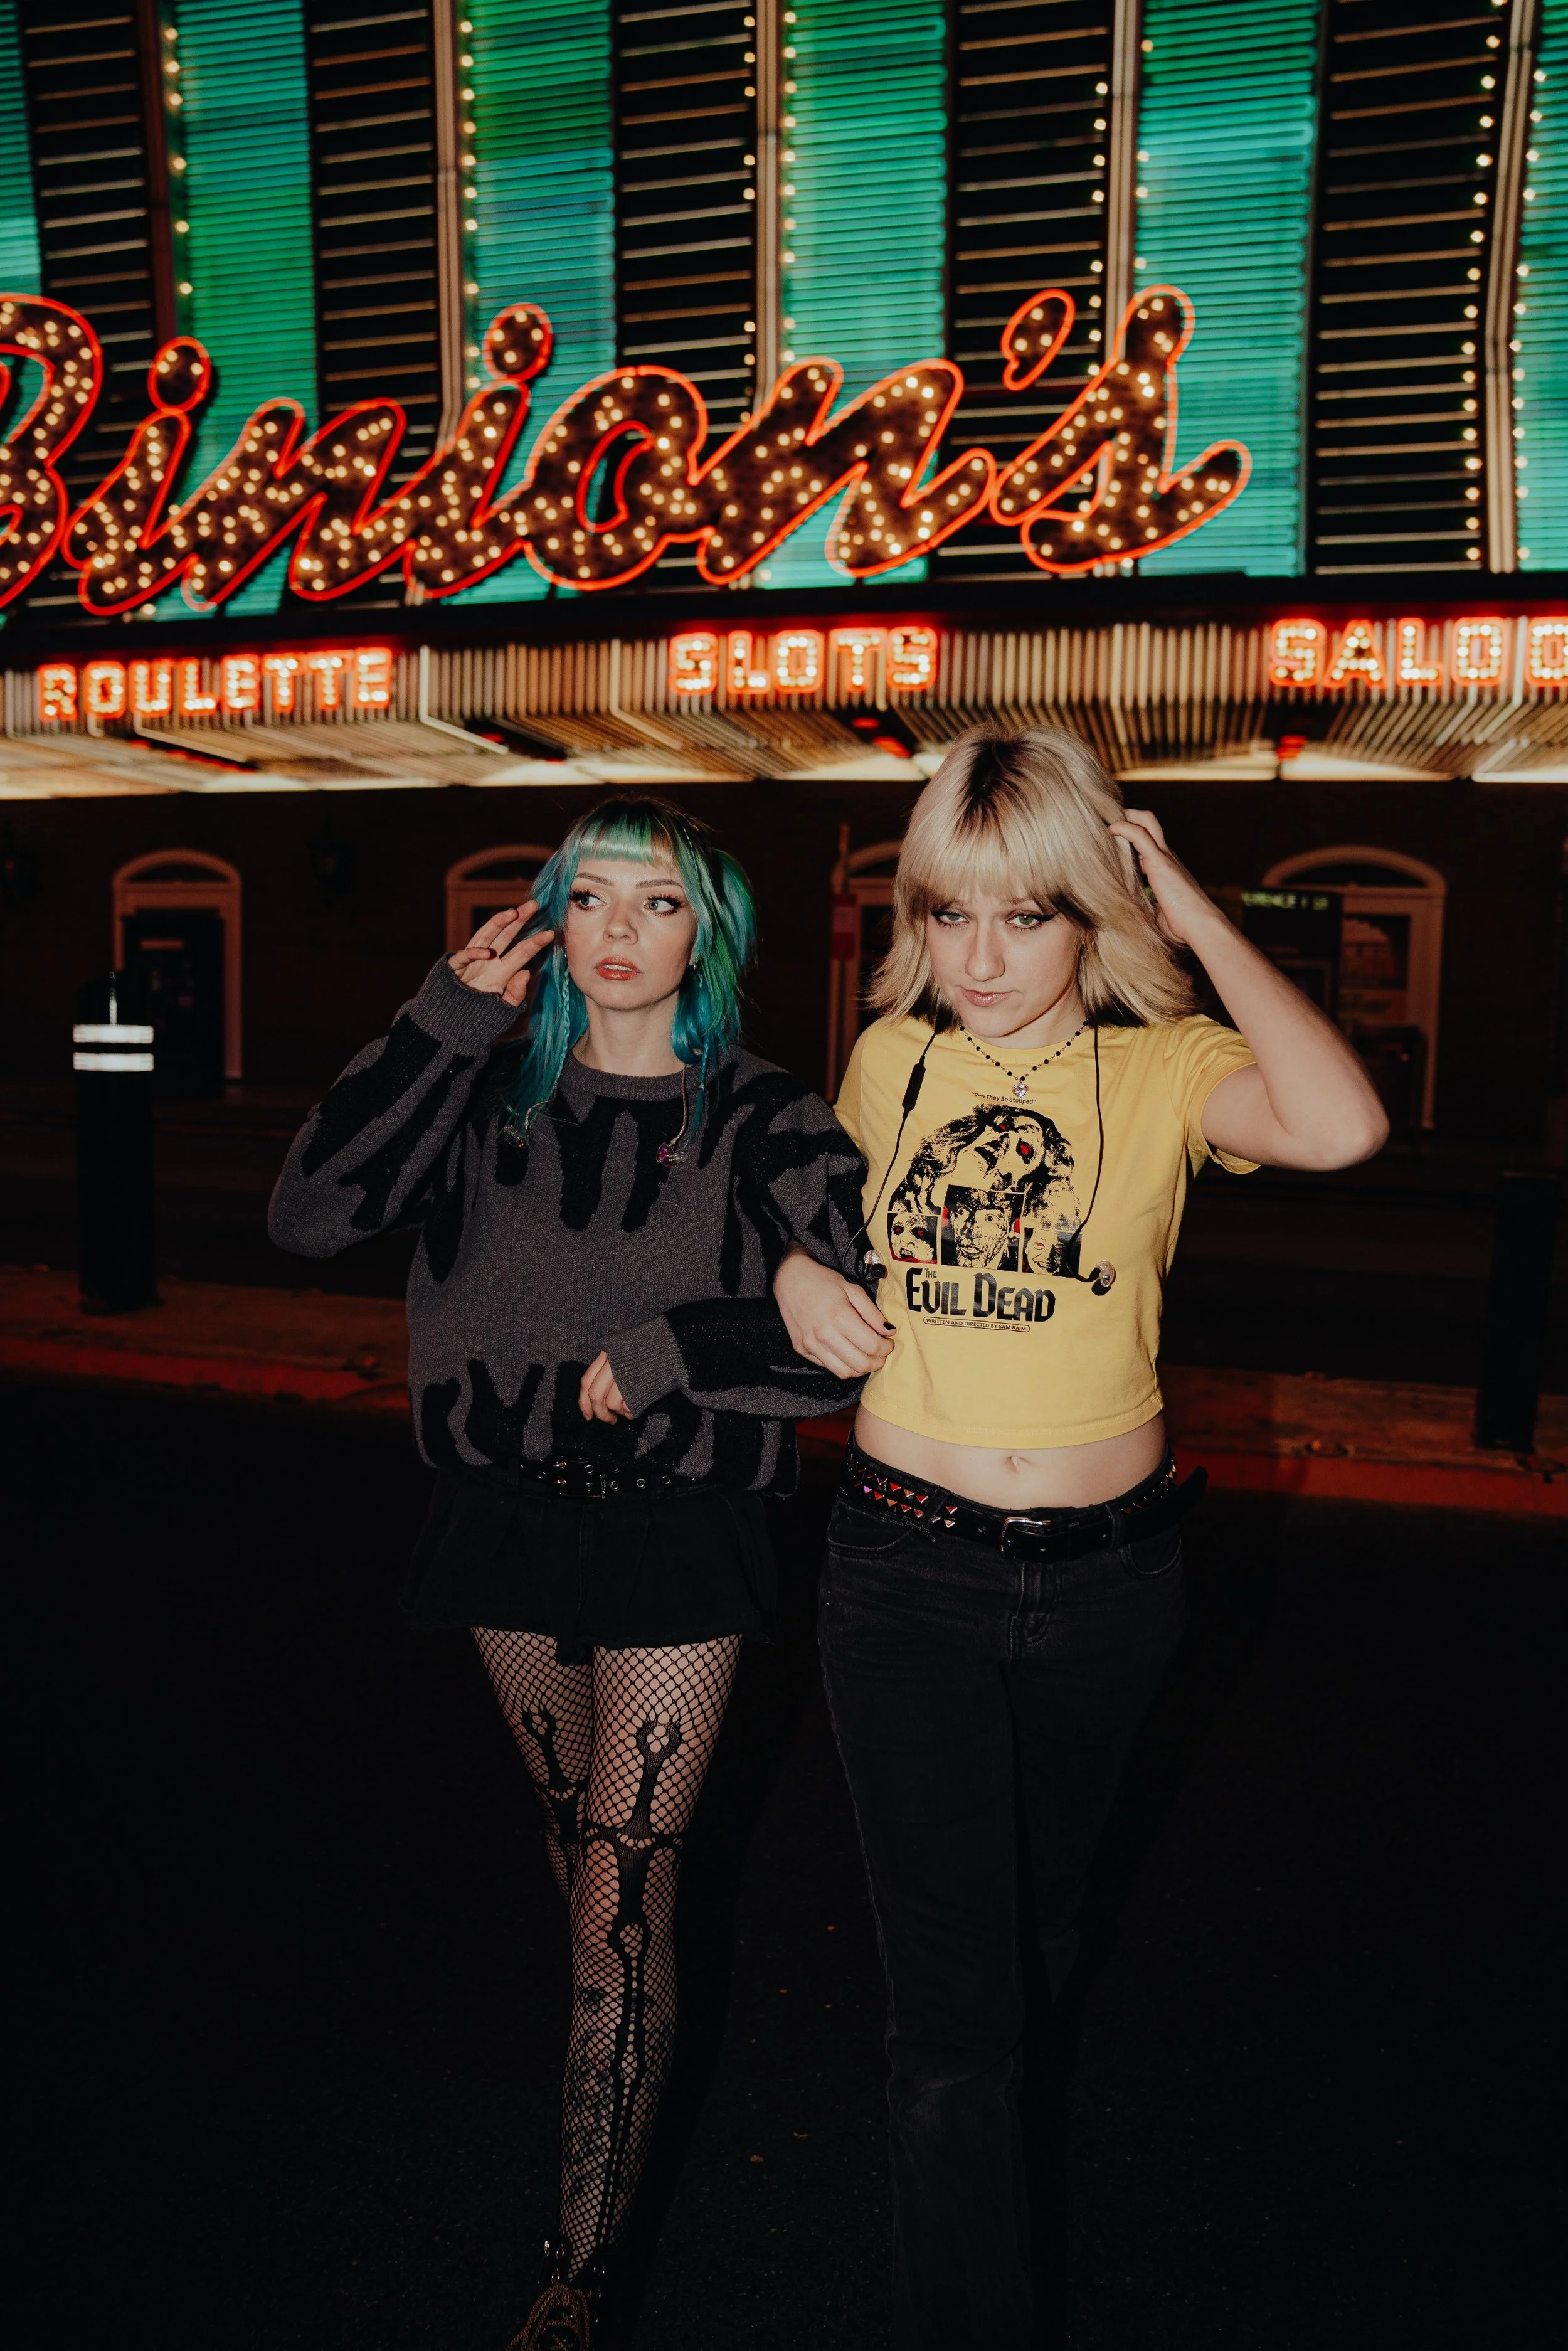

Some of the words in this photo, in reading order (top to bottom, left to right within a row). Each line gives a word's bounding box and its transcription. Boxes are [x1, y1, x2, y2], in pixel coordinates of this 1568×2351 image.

[38, 647, 393, 721] ROULETTE
[669, 626, 936, 696] SLOTS
[1268, 615, 1568, 689] SALOO
[906, 1267, 967, 1316] EVIL
[973, 1272, 1056, 1322] DEAD
[924, 1268, 937, 1278] THE
